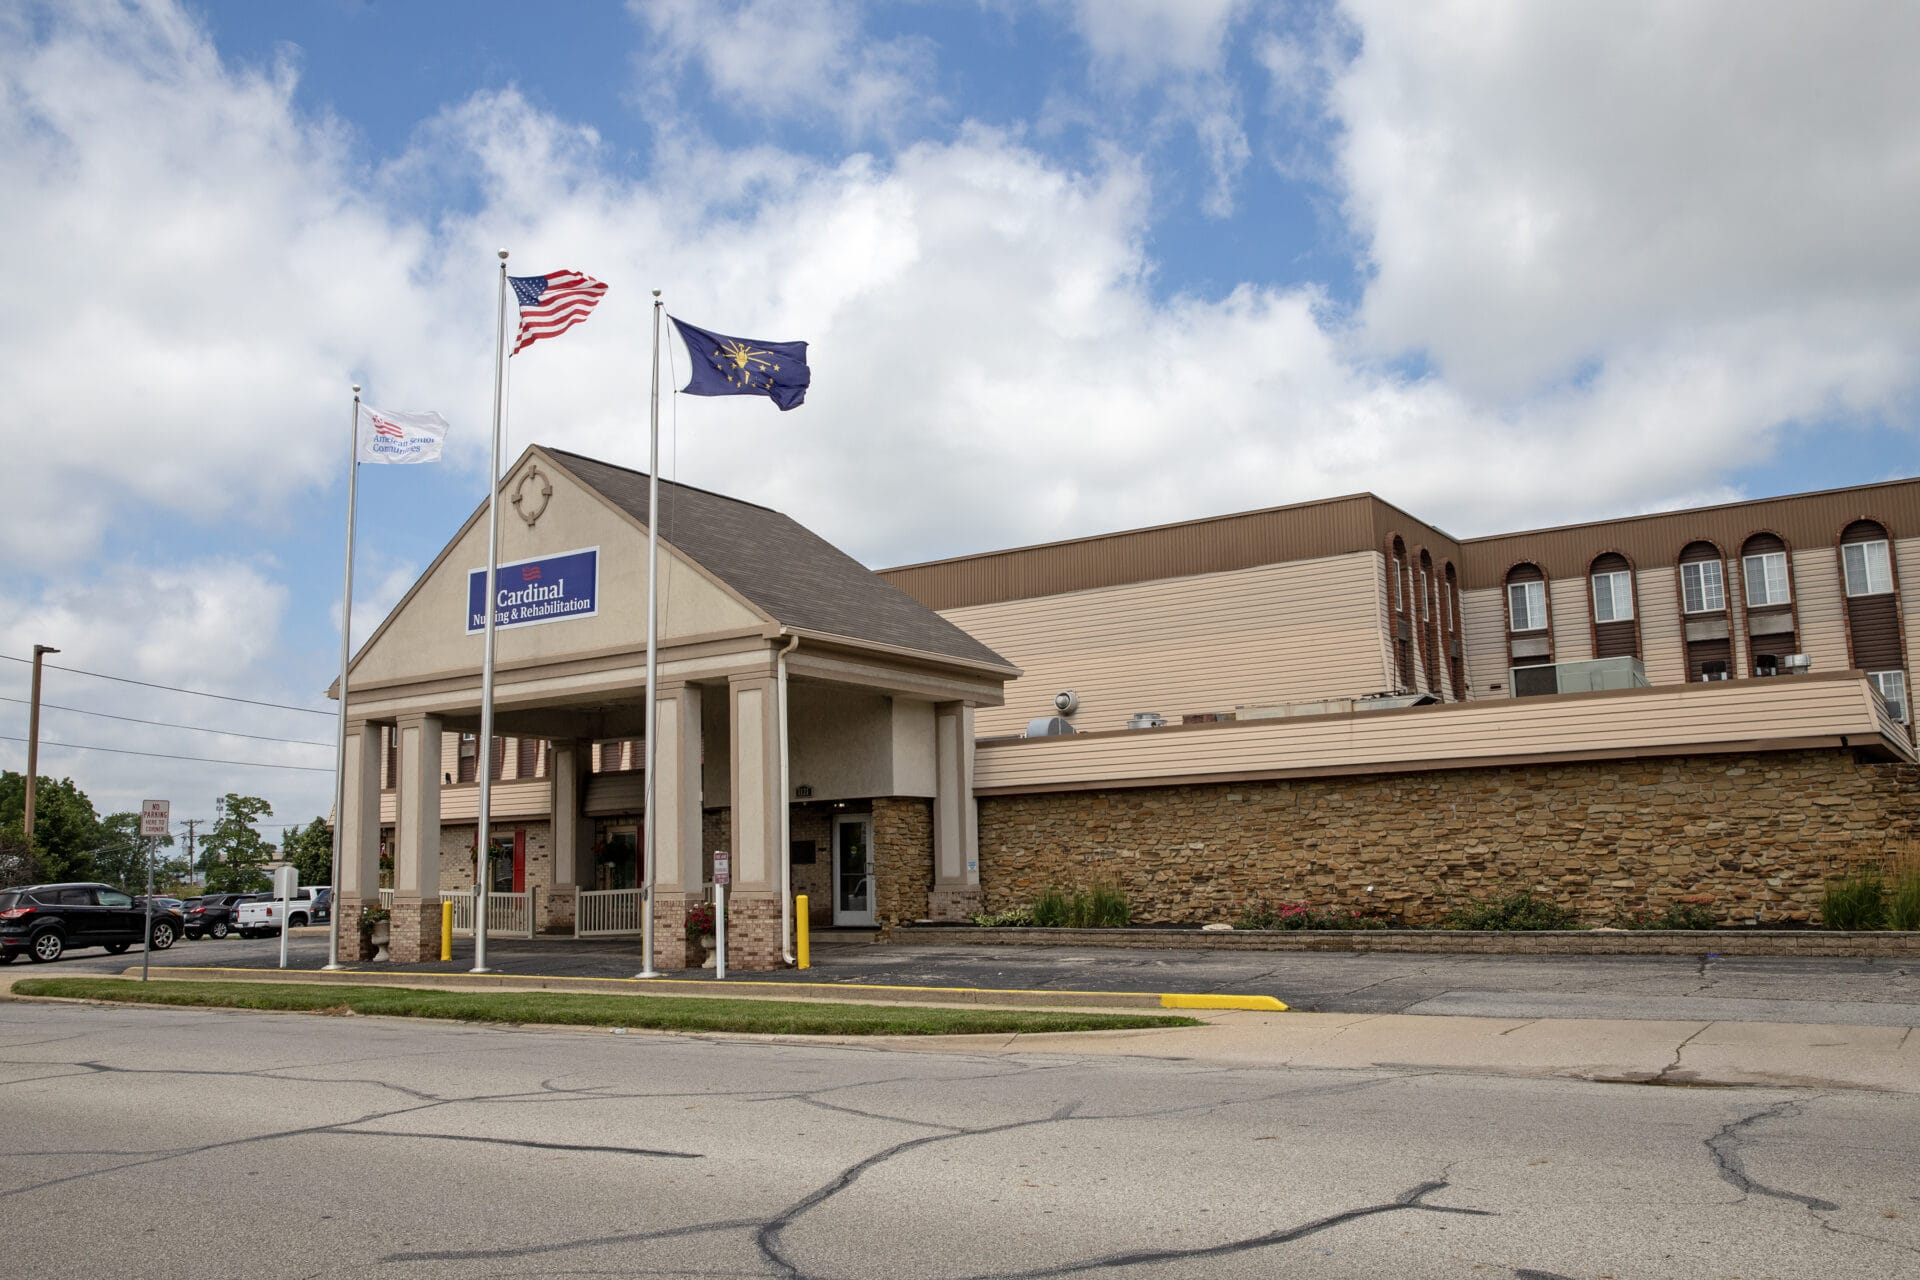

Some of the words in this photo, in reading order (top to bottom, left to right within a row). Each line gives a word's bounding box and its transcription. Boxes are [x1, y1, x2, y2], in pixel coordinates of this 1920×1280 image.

[497, 578, 564, 607] Cardinal
[473, 610, 510, 626] Nuing
[511, 608, 518, 620] &
[520, 597, 590, 618] Rehabilitation
